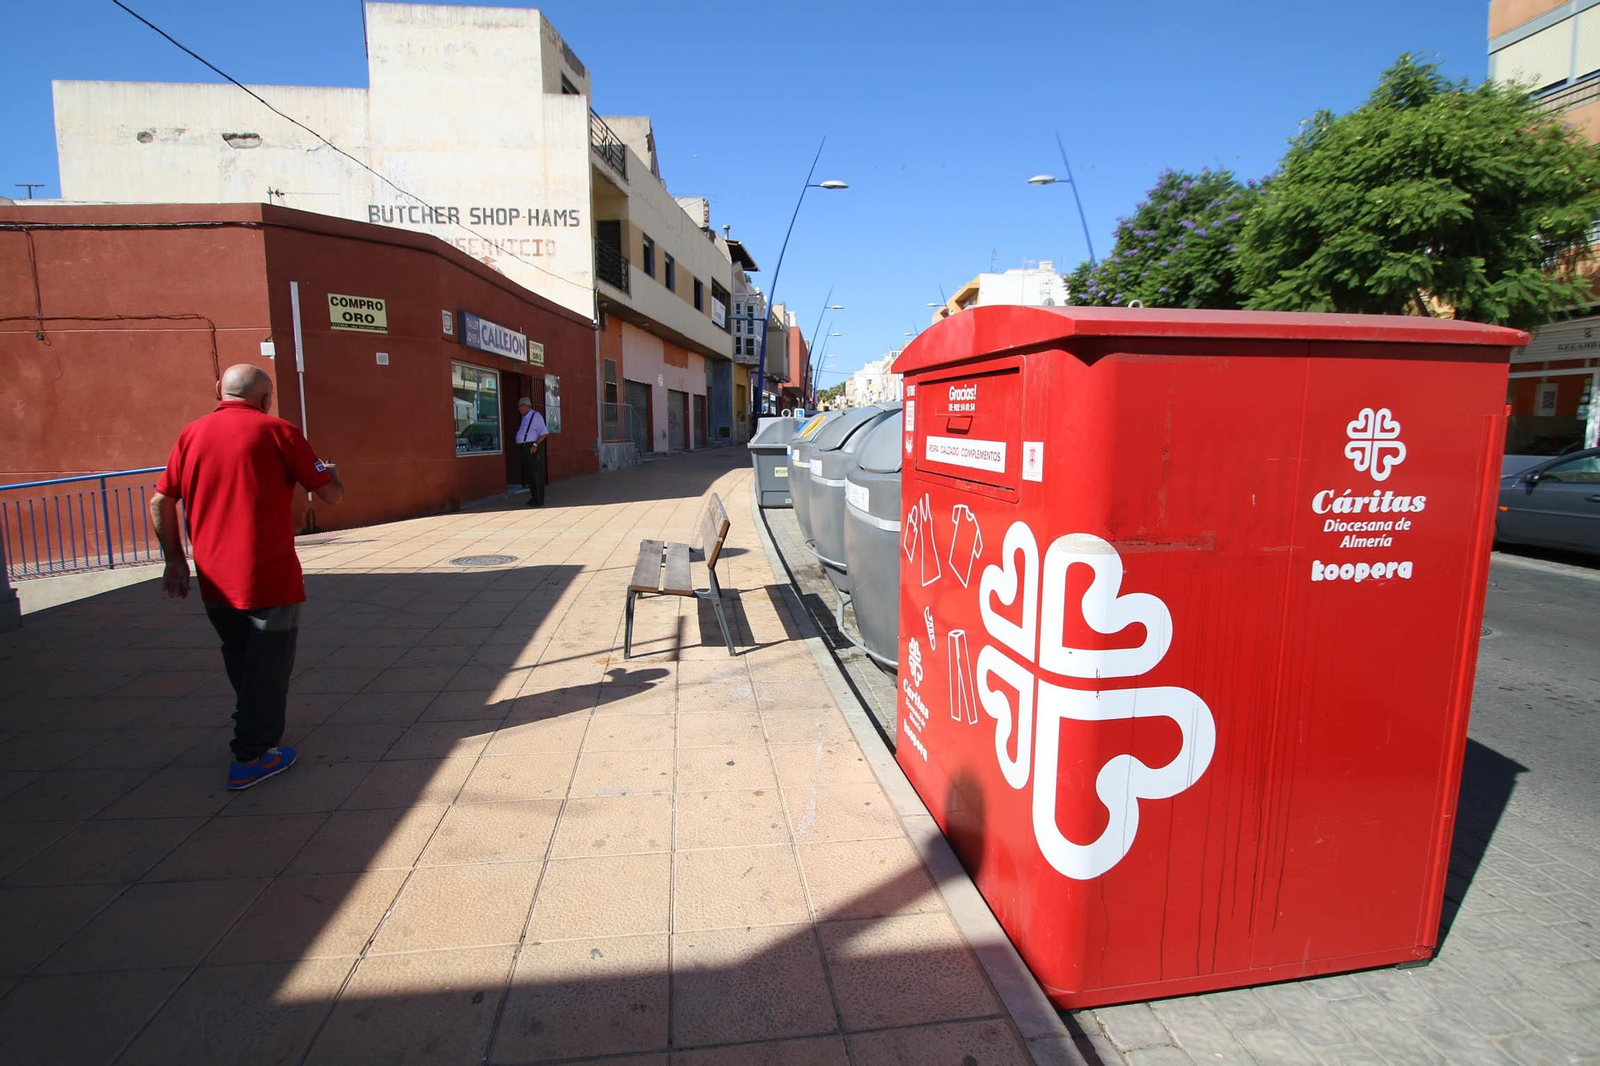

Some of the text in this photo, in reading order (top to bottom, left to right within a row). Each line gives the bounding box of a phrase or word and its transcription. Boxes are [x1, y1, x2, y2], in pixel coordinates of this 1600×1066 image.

[368, 205, 460, 225] BUTCHER
[330, 296, 383, 311] COMPRO
[342, 311, 375, 324] ORO
[482, 325, 526, 356] CALLEJON
[948, 383, 977, 401] Gracias!
[929, 444, 1001, 462] ROPA CALZADO COMPLEMENTOS
[1311, 488, 1427, 514] Cáritas
[1323, 517, 1412, 533] Diocesana de
[1339, 533, 1393, 549] Almería
[1310, 560, 1414, 583] koopera
